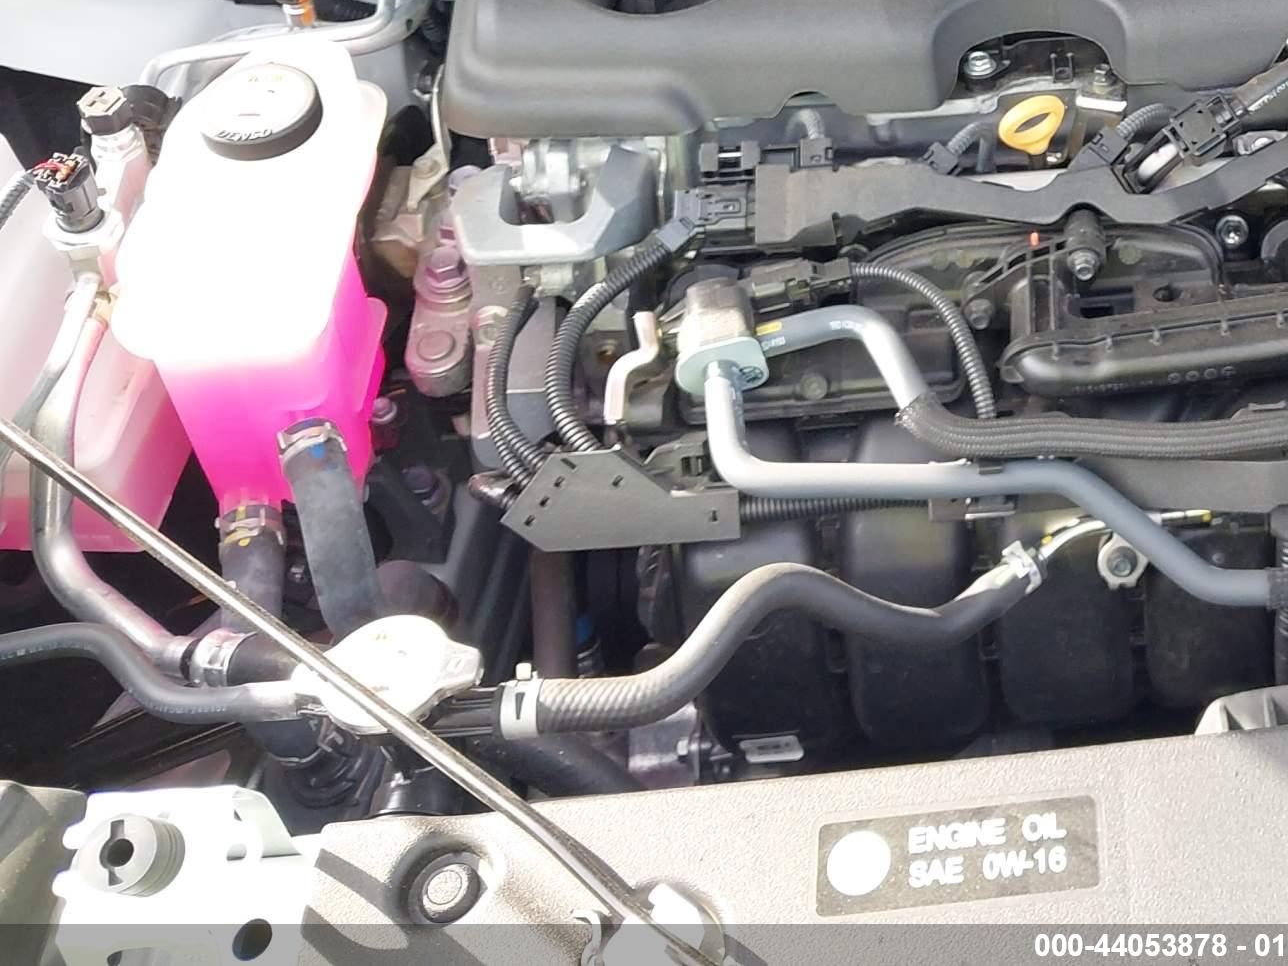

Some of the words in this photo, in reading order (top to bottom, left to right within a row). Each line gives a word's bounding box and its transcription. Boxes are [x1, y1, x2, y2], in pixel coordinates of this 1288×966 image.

[214, 128, 273, 142] DENSO
[908, 818, 1006, 853] ENGINE
[1022, 813, 1067, 842] OIL
[908, 857, 964, 887] SAE
[982, 846, 1067, 880] 0W-16
